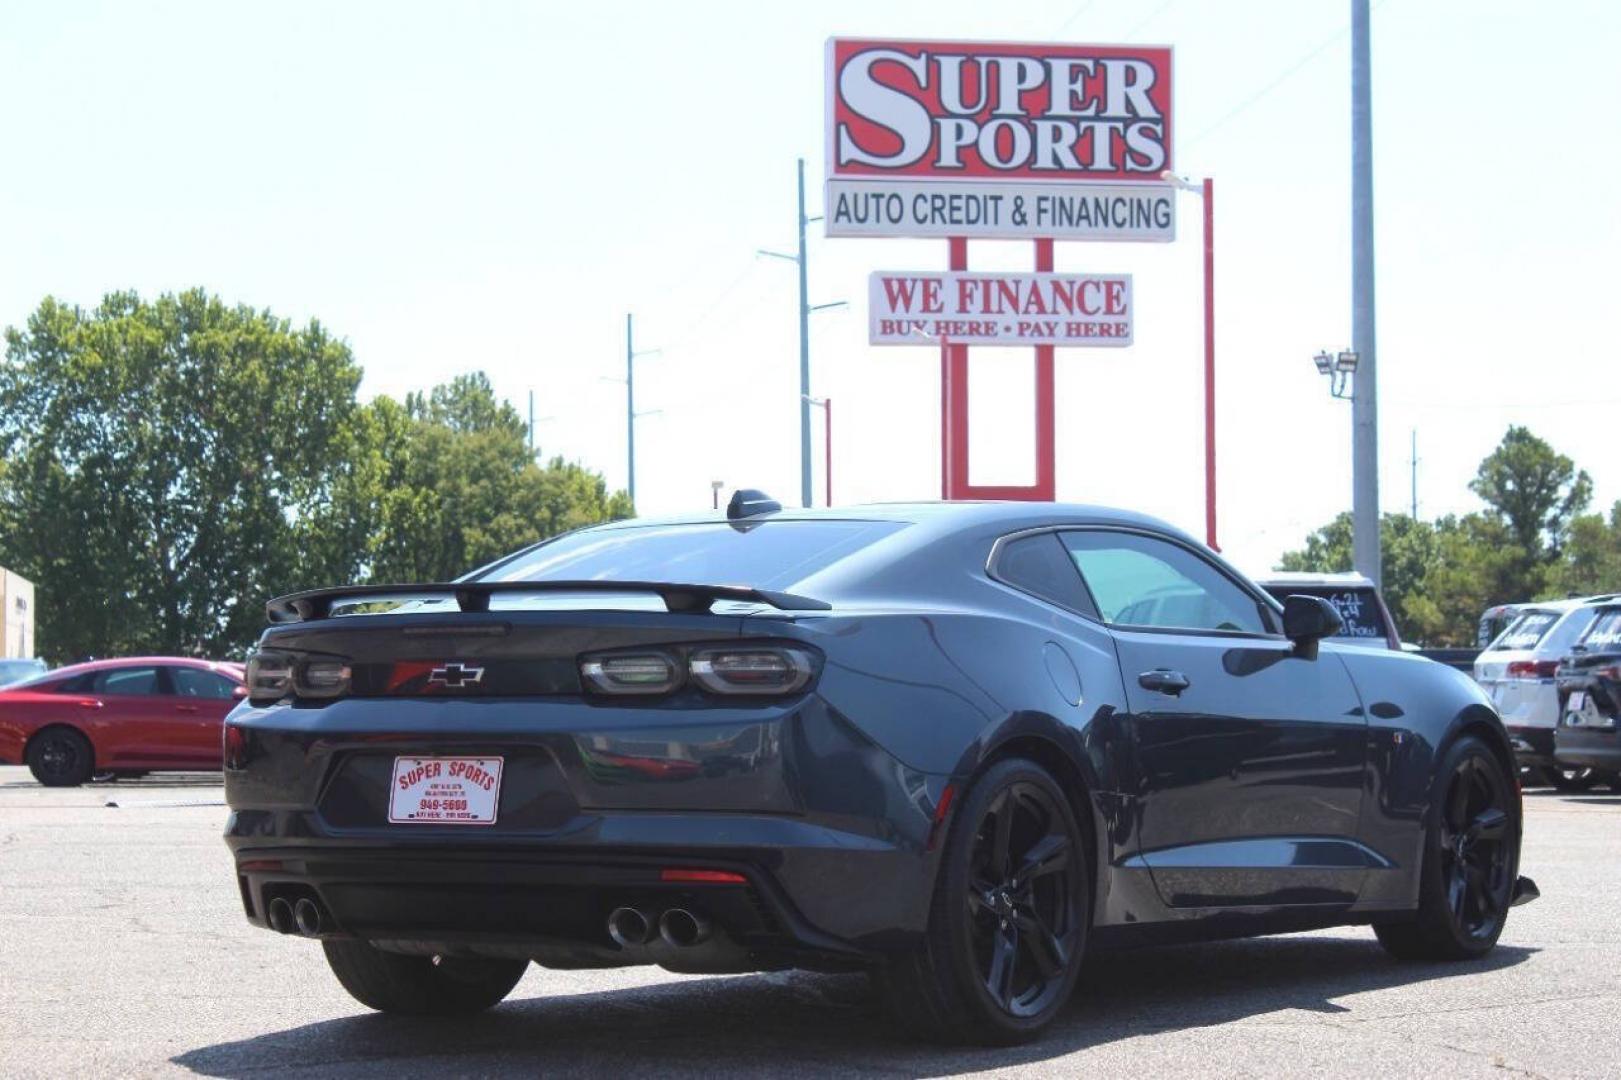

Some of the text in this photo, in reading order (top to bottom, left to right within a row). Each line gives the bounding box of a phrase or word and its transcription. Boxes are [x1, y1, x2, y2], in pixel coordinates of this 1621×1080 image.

[835, 193, 1171, 228] AUTO CREDIT & FINANCING
[882, 277, 1128, 316] WE FINANCE
[880, 319, 1129, 338] BUY HERE PAY HERE
[399, 761, 494, 791] SUPER SPORTS
